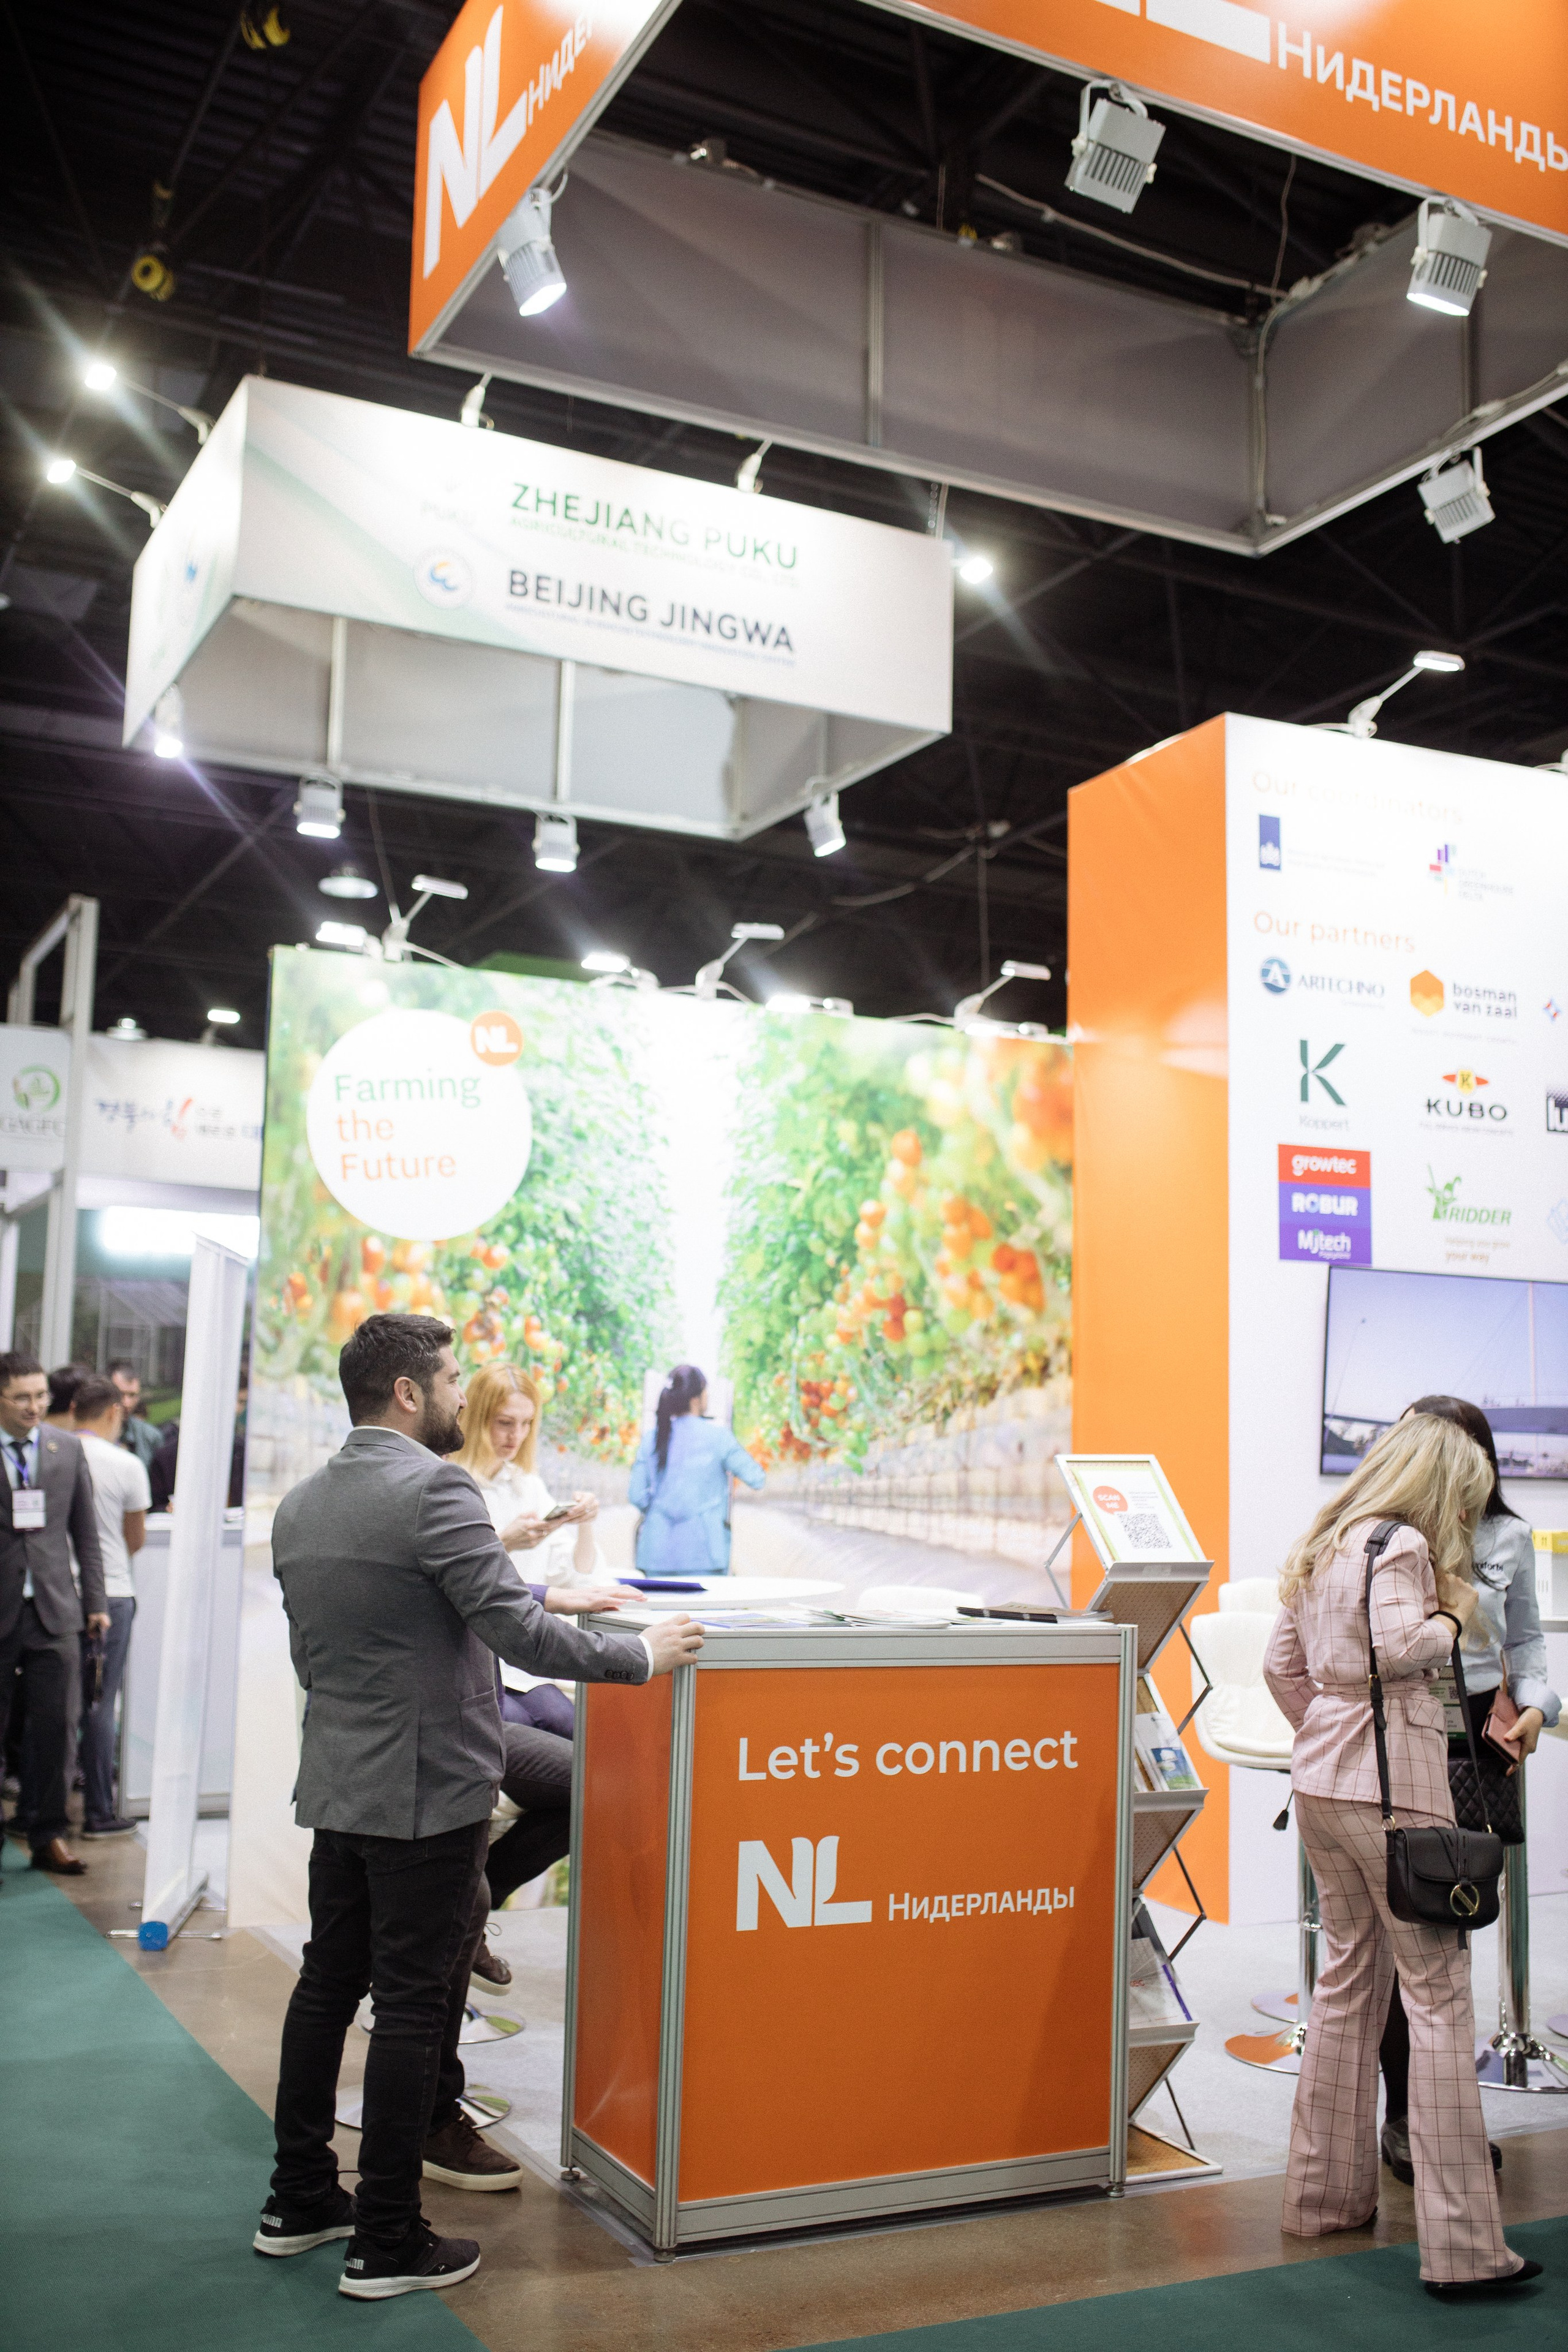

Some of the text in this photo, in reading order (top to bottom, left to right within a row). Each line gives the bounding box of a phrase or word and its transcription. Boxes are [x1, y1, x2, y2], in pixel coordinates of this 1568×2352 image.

[423, 5, 527, 280] NL
[511, 482, 798, 569] ZHEJIANG PUKU
[509, 570, 647, 622] BEIJING
[661, 603, 794, 652] JINGWA
[1252, 771, 1297, 796] Our
[1254, 910, 1415, 954] Our partners
[1453, 982, 1517, 1002] bosman
[1453, 1001, 1518, 1018] van zaal
[475, 1025, 518, 1053] NL
[335, 1068, 481, 1109] Farming
[1427, 1099, 1507, 1120] KUBO
[337, 1109, 394, 1142] the
[341, 1153, 456, 1182] Future
[1292, 1155, 1357, 1177] growtec
[1292, 1192, 1358, 1216] ROBUR
[1448, 1207, 1512, 1226] RIDDER
[876, 1731, 1078, 1776] connect
[736, 1835, 872, 1931] NL
[262, 2214, 282, 2228] UMA
